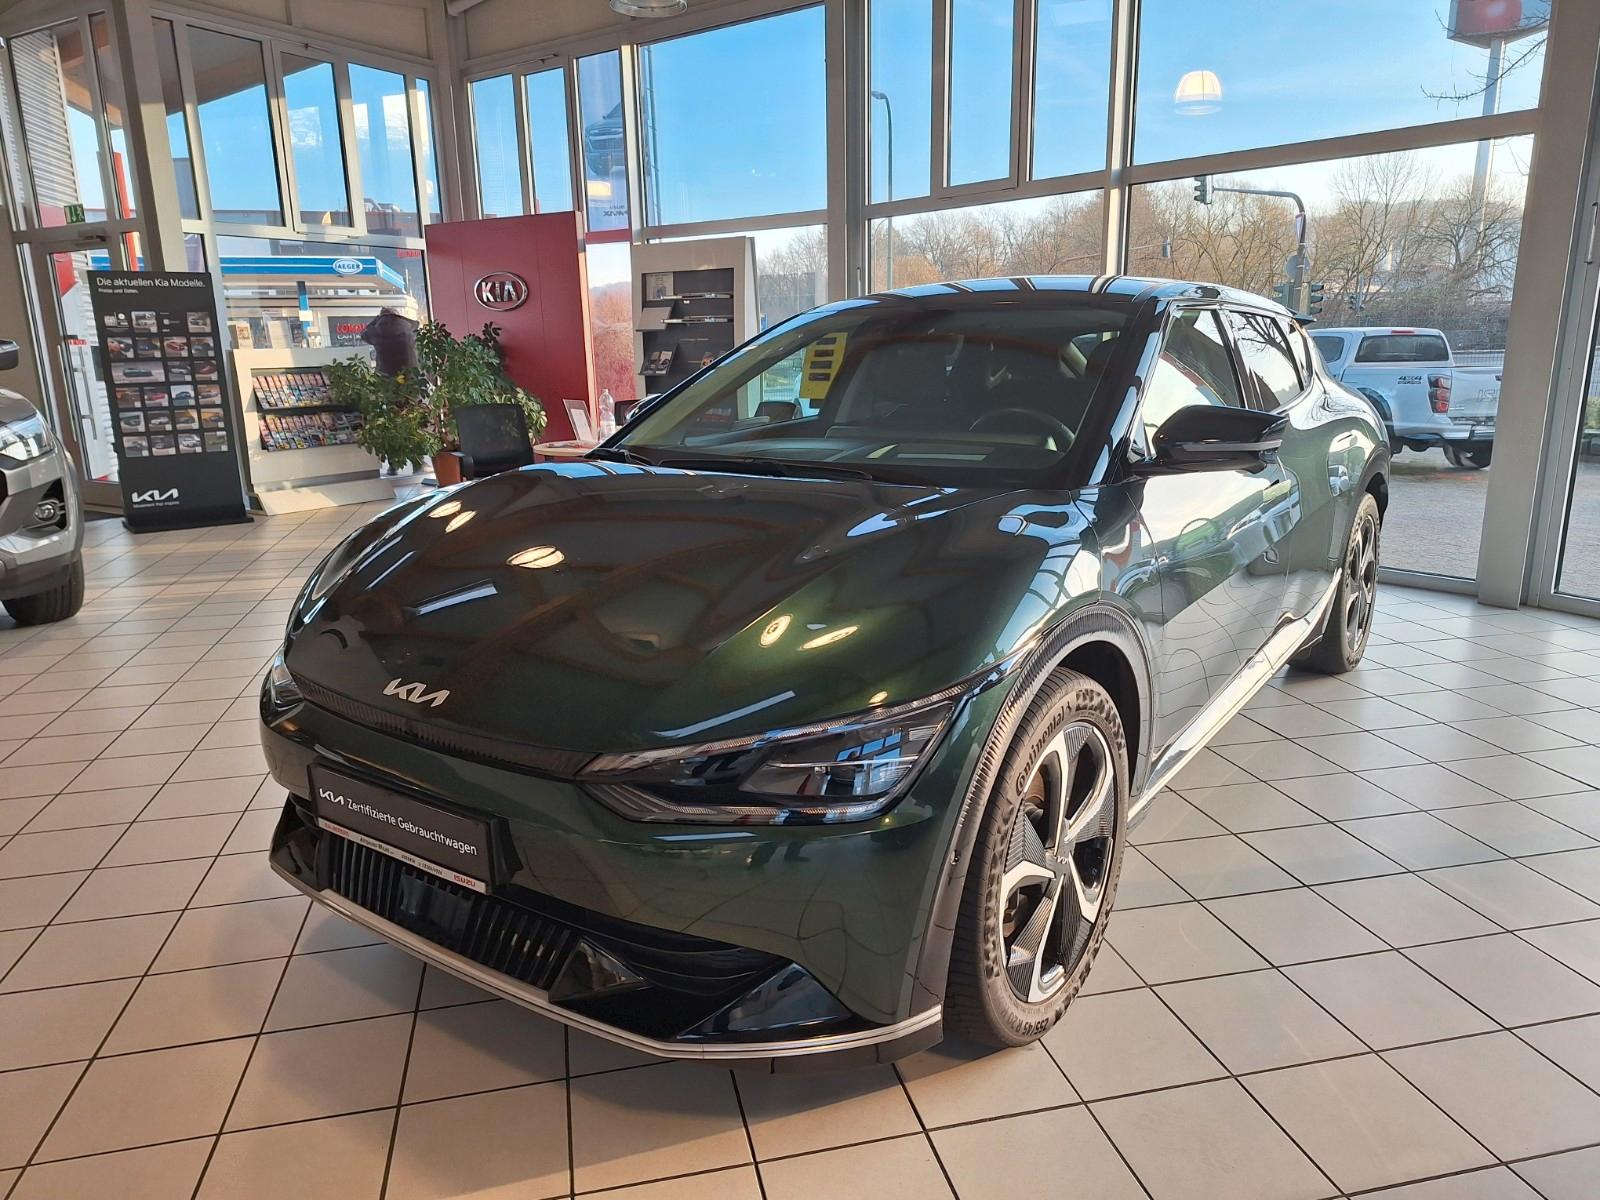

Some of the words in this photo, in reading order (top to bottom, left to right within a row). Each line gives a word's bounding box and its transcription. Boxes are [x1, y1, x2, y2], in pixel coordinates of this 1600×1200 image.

[96, 276, 112, 286] Die
[113, 277, 154, 287] aktuellen
[155, 278, 169, 287] Kia
[170, 278, 206, 288] Modelle.
[481, 280, 518, 302] KIA
[131, 488, 179, 503] KIA
[383, 678, 450, 708] KIA
[1016, 705, 1066, 797] Continental
[319, 788, 345, 806] KIA
[346, 798, 396, 826] Zertifizierte
[397, 817, 478, 856] Gebrauchtwagen
[453, 874, 476, 888] ISUZU
